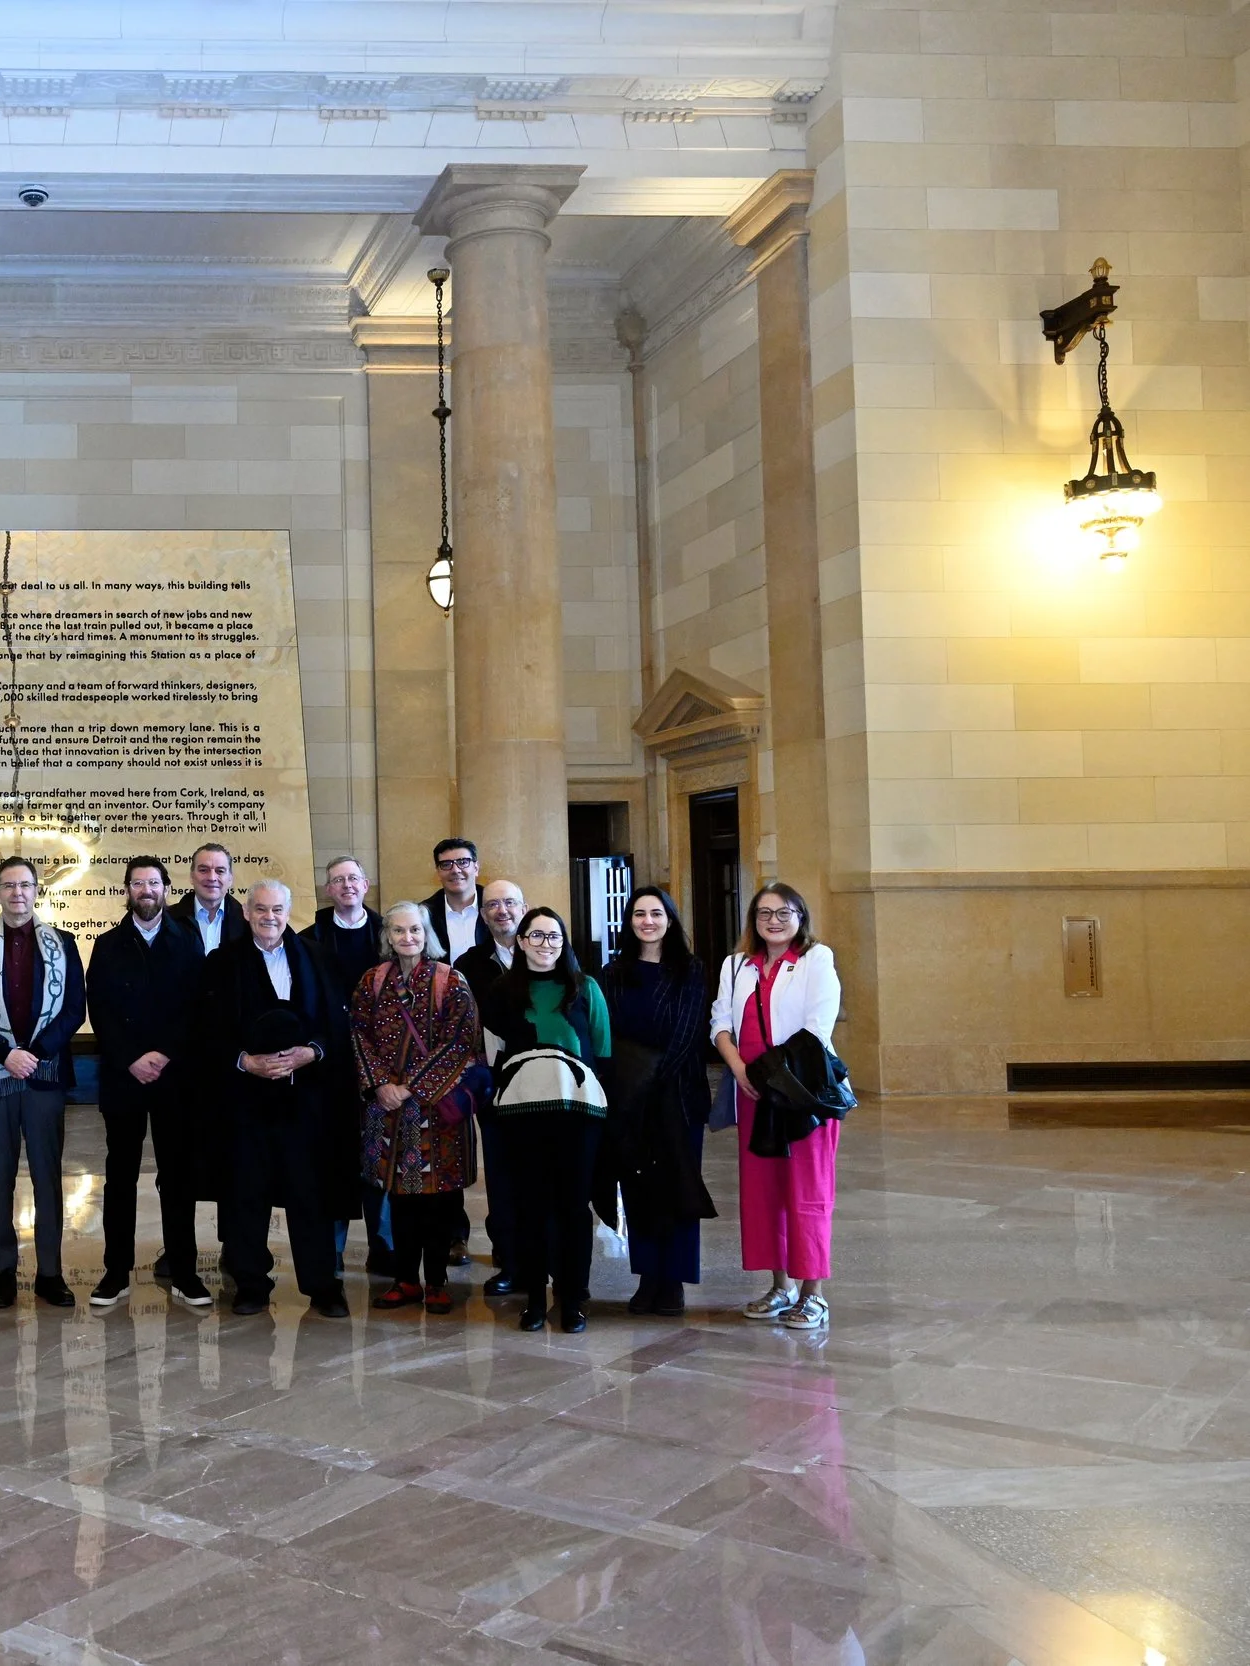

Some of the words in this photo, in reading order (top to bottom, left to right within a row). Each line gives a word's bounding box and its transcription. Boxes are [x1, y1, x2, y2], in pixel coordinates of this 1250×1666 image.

[20, 581, 42, 590] deal
[104, 583, 132, 592] many
[134, 583, 164, 592] ways,
[167, 580, 184, 590] this
[187, 580, 228, 592] building
[230, 580, 250, 590] tells
[20, 610, 52, 619] where
[54, 610, 102, 619] dreamers
[115, 609, 148, 619] search
[186, 609, 207, 621] jobs
[63, 621, 81, 630] last
[83, 621, 106, 630] train
[110, 621, 141, 632] pulled
[174, 620, 214, 630] became
[226, 620, 253, 632] place
[60, 632, 84, 641] hard
[86, 632, 116, 641] times.
[129, 632, 183, 641] monument
[211, 631, 259, 643] struggles.
[25, 650, 45, 660] that
[65, 650, 126, 662] reimagining
[129, 650, 147, 659] this
[150, 650, 185, 659] Station
[214, 650, 241, 661] place
[76, 681, 102, 690] team
[117, 681, 158, 690] forward
[160, 680, 203, 691] thinkers,
[205, 680, 256, 692] designers,
[26, 693, 58, 702] skilled
[61, 692, 128, 704] tradespeople
[131, 692, 170, 702] worked
[172, 692, 216, 704] tirelessly
[231, 692, 258, 703] bring
[51, 723, 73, 733] than
[88, 723, 105, 735] trip
[110, 723, 138, 733] down
[143, 725, 185, 735] memory
[189, 723, 214, 732] lane.
[218, 723, 237, 732] This
[92, 735, 127, 744] Detroit
[170, 734, 204, 746] region
[206, 734, 242, 744] remain
[42, 747, 62, 756] that
[64, 746, 119, 756] innovation
[132, 746, 165, 756] driven
[203, 746, 261, 755] intersection
[42, 758, 63, 768] that
[76, 760, 123, 770] company
[127, 758, 160, 767] should
[183, 758, 207, 767] exist
[210, 758, 242, 767] unless
[89, 788, 124, 798] moved
[127, 788, 150, 798] here
[152, 788, 178, 797] from
[179, 788, 207, 799] Cork,
[210, 788, 249, 798] Ireland,
[27, 801, 62, 810] farmer
[105, 800, 149, 810] inventor.
[175, 800, 215, 812] family's
[218, 802, 265, 811] company
[57, 812, 100, 824] together
[105, 814, 128, 822] over
[151, 814, 183, 824] years.
[187, 812, 229, 823] Through
[84, 824, 107, 834] their
[111, 824, 183, 833] determination
[187, 824, 207, 833] that
[211, 823, 245, 833] Detroit
[249, 823, 267, 833] will
[244, 854, 269, 865] days
[63, 918, 107, 930] together
